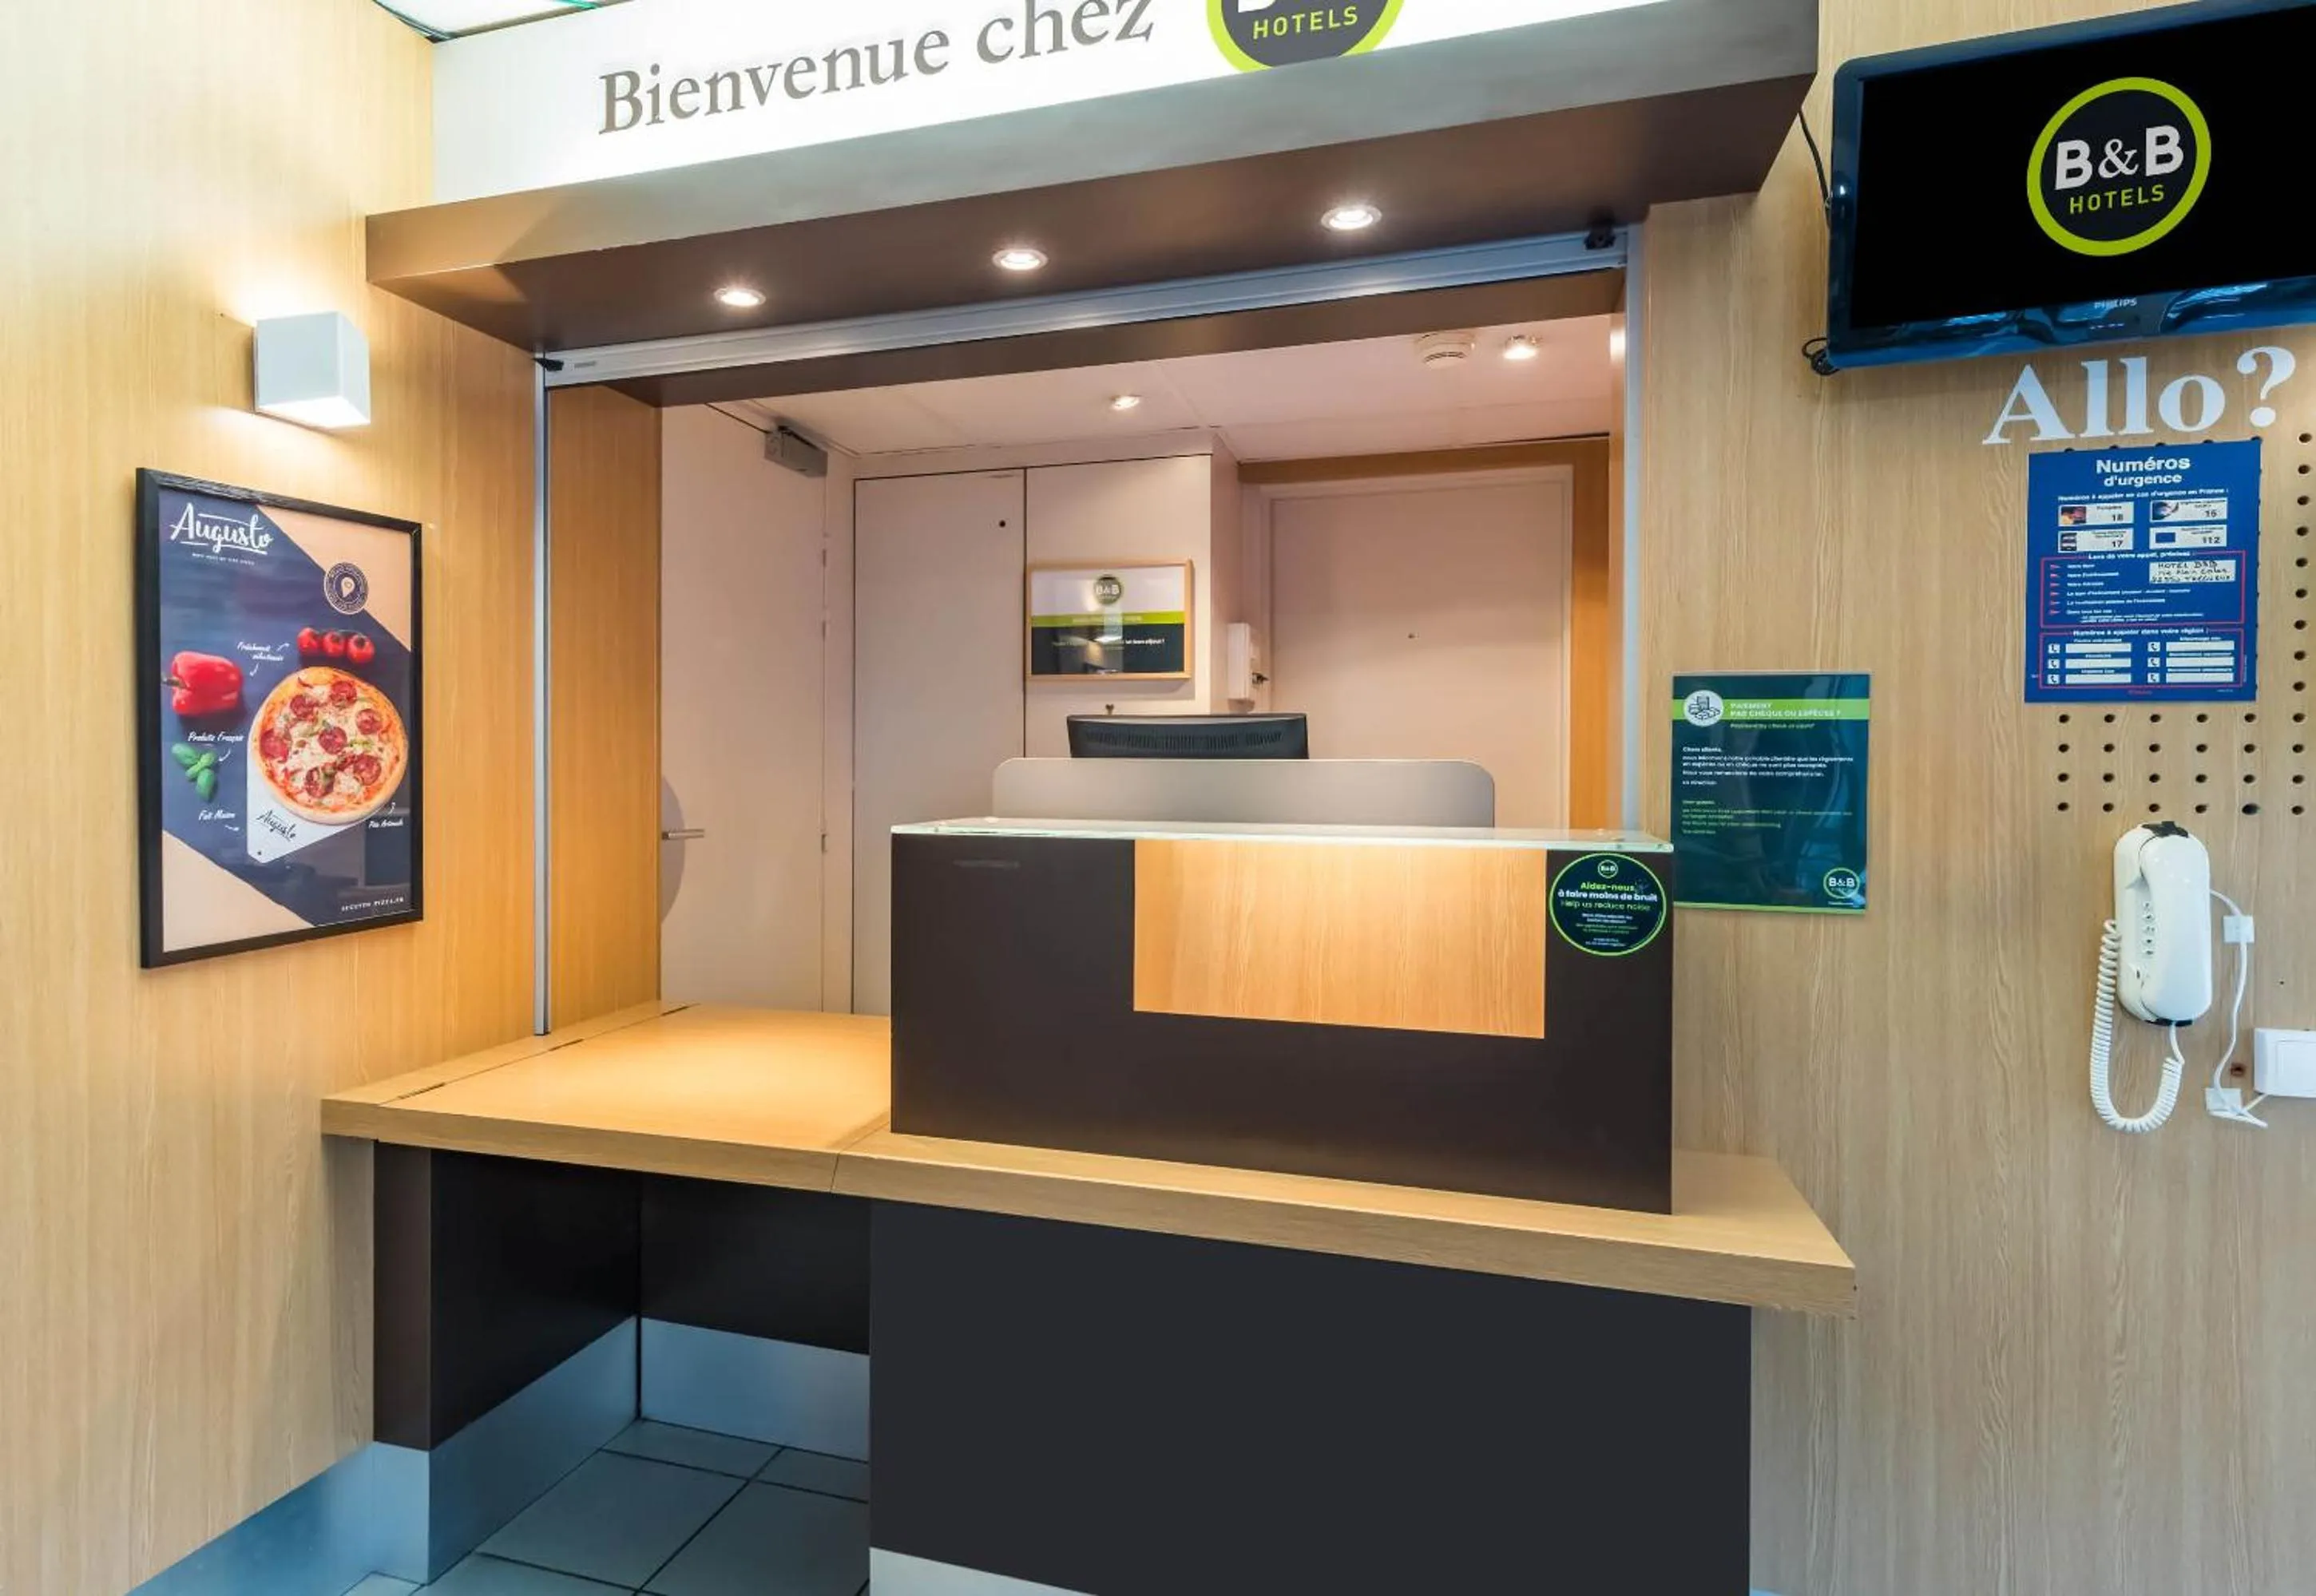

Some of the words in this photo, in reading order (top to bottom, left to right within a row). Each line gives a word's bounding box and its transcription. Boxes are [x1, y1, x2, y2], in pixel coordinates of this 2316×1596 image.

[1253, 6, 1358, 40] HOTELS
[598, 28, 950, 134] Bienvenue
[977, 0, 1154, 64] chez
[2055, 125, 2185, 191] B&B
[2069, 184, 2165, 214] HOTELS
[2096, 456, 2191, 473] Numéros
[2104, 473, 2183, 488] d'urgence
[169, 502, 274, 553] Augusto
[1580, 881, 1636, 892] Aidez-nous
[1828, 877, 1855, 887] B&B
[1557, 889, 1564, 897] à
[1565, 889, 1588, 898] faire
[1588, 890, 1619, 900] moins
[1620, 892, 1632, 901] de
[1633, 893, 1658, 902] bruit
